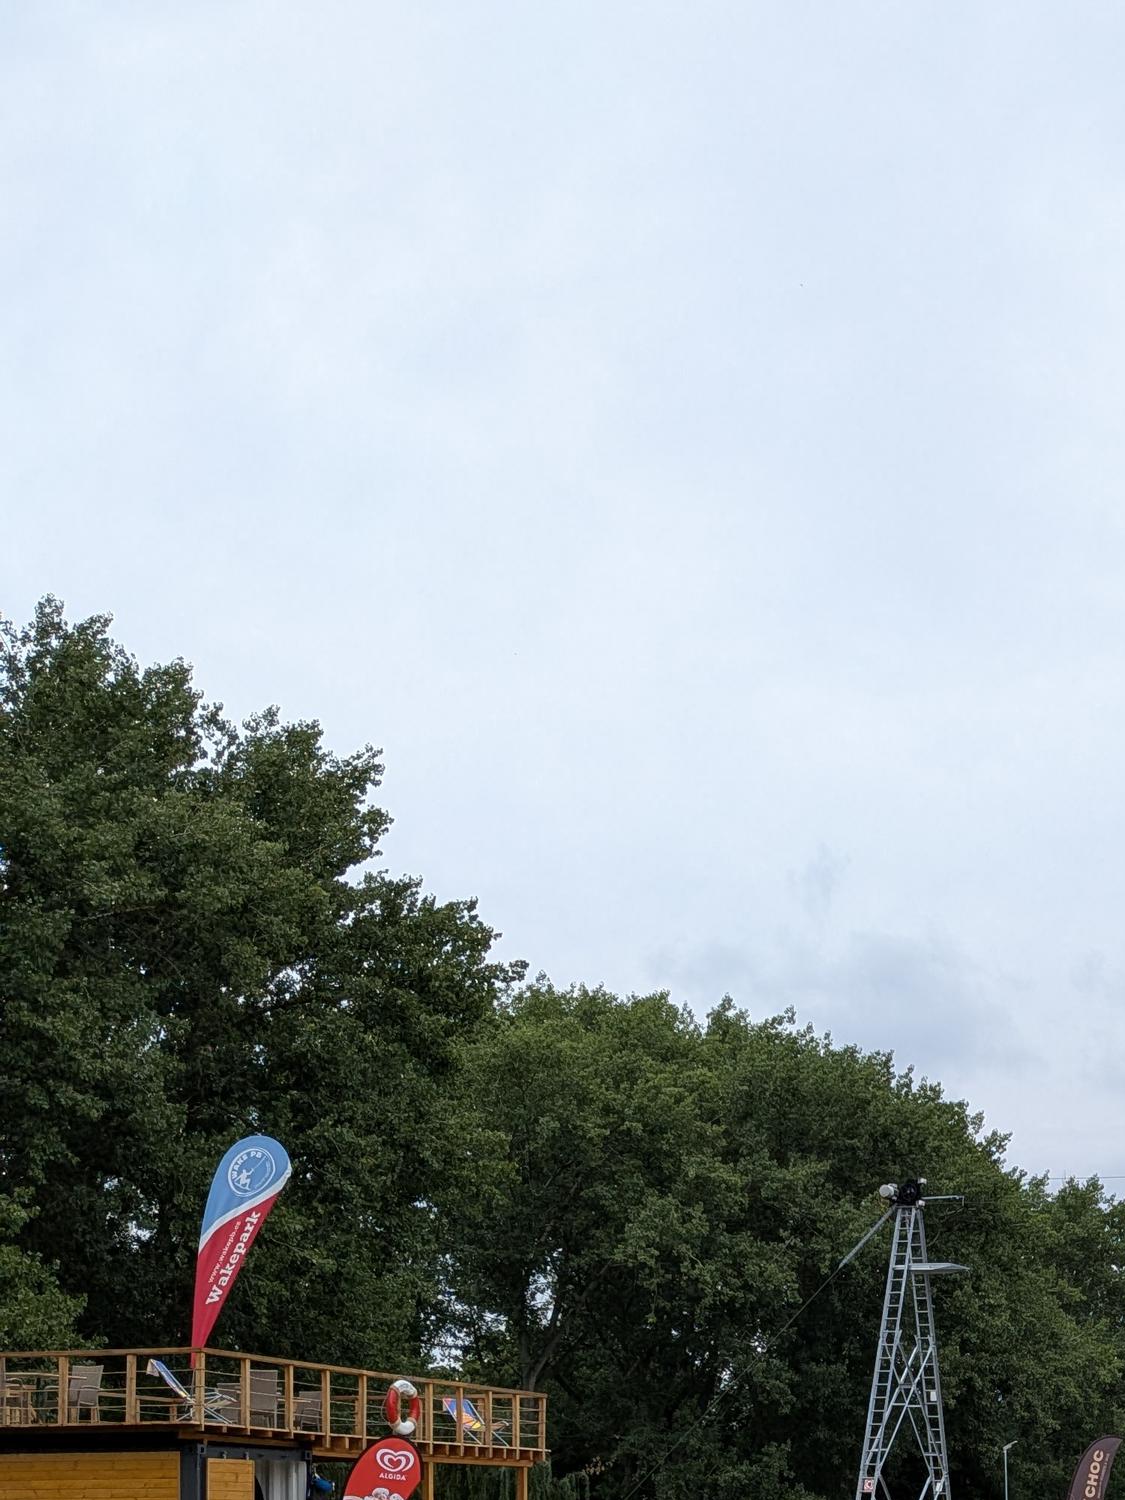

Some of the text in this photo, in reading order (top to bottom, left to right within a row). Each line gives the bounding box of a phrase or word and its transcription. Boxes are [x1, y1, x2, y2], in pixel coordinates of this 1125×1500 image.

[231, 1153, 249, 1180] WAKE
[250, 1151, 263, 1159] PB
[205, 1211, 261, 1305] Wakepark
[379, 1472, 407, 1481] ALGIDA
[1085, 1449, 1104, 1498] CHOC
